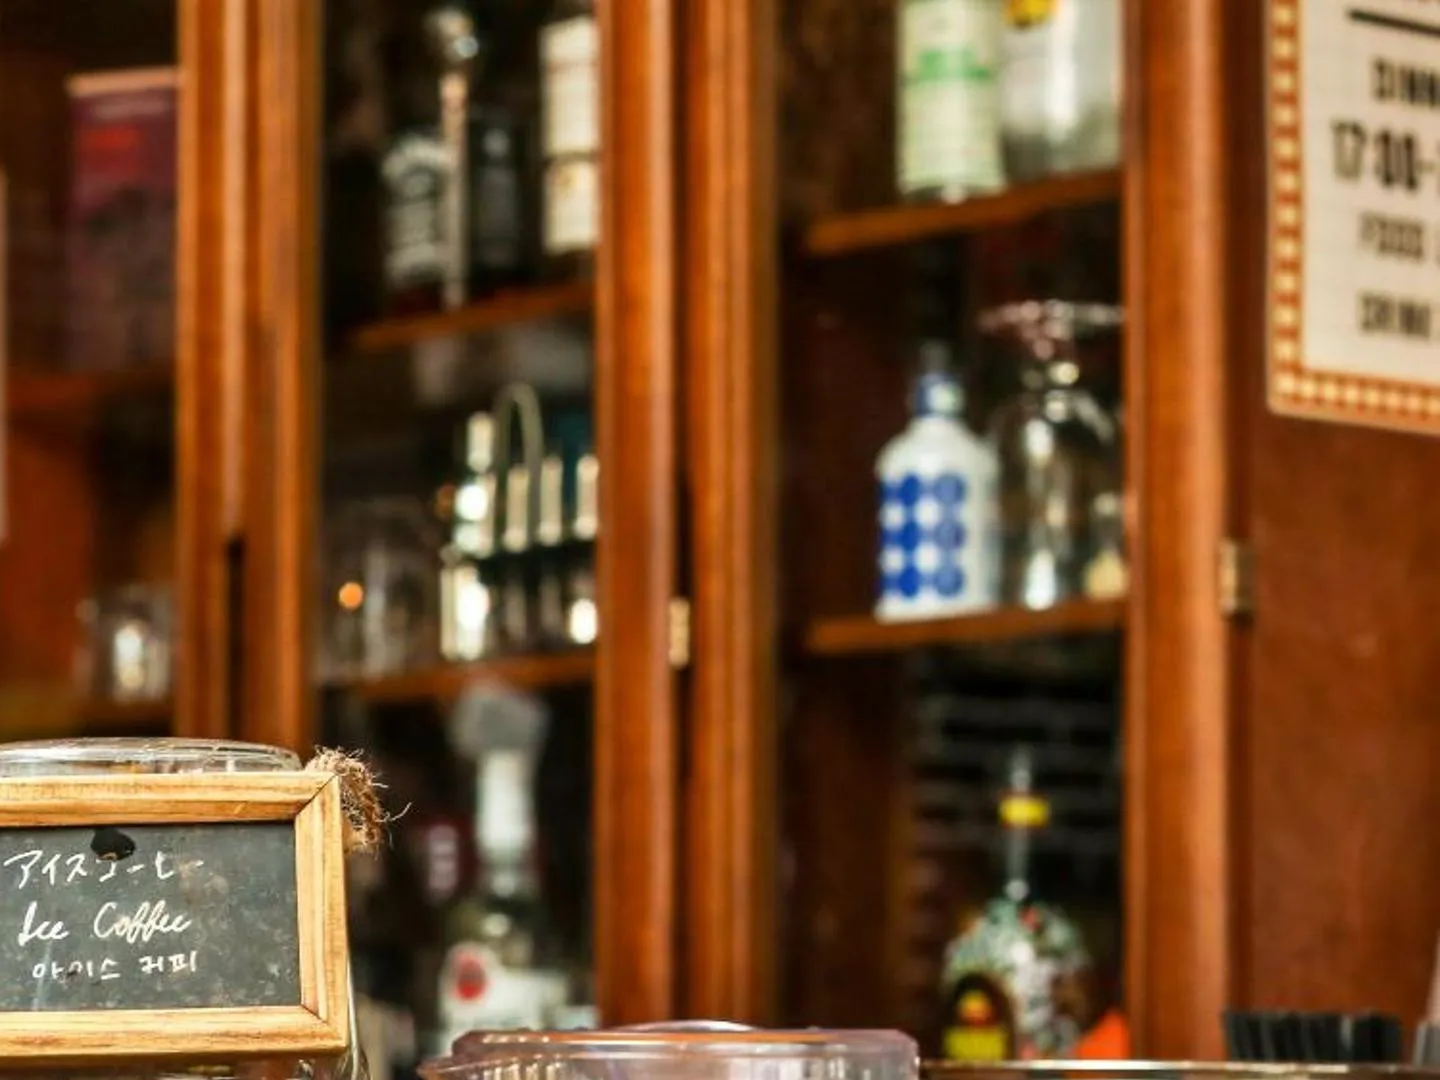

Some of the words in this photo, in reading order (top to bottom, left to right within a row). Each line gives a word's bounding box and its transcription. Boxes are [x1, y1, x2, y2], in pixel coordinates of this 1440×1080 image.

[18, 900, 71, 947] Ice
[92, 899, 193, 944] Coffee
[31, 957, 121, 981] 아이스
[138, 950, 198, 975] 커피
